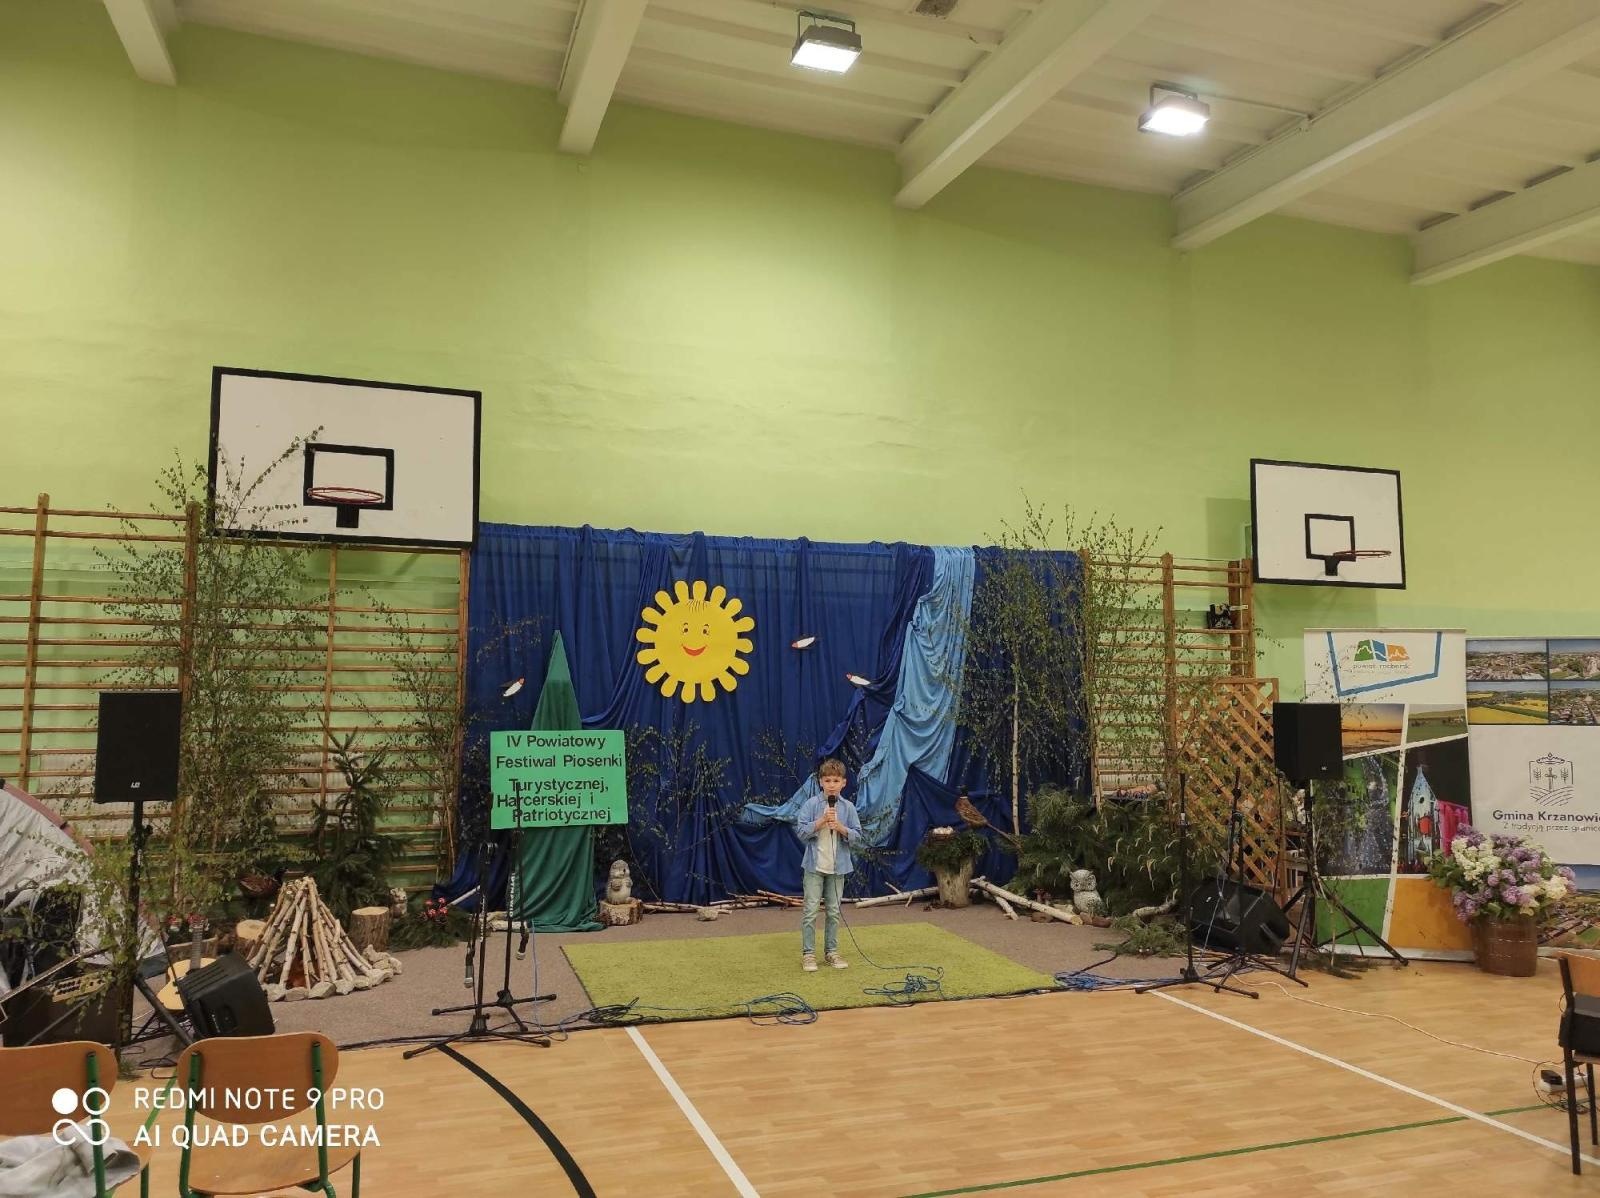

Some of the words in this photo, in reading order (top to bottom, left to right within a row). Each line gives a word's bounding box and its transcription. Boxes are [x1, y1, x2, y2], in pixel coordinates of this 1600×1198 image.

[506, 735, 522, 748] IV
[527, 734, 606, 750] Powiatowy
[496, 755, 556, 769] Festiwal
[563, 753, 623, 768] Piosenki
[508, 777, 609, 794] Turystycznej,
[497, 792, 582, 809] Harcerskiej
[590, 791, 595, 805] i
[512, 807, 611, 824] Patriotycznej
[1492, 809, 1534, 821] Gmina
[1538, 810, 1600, 823] Krzanowi
